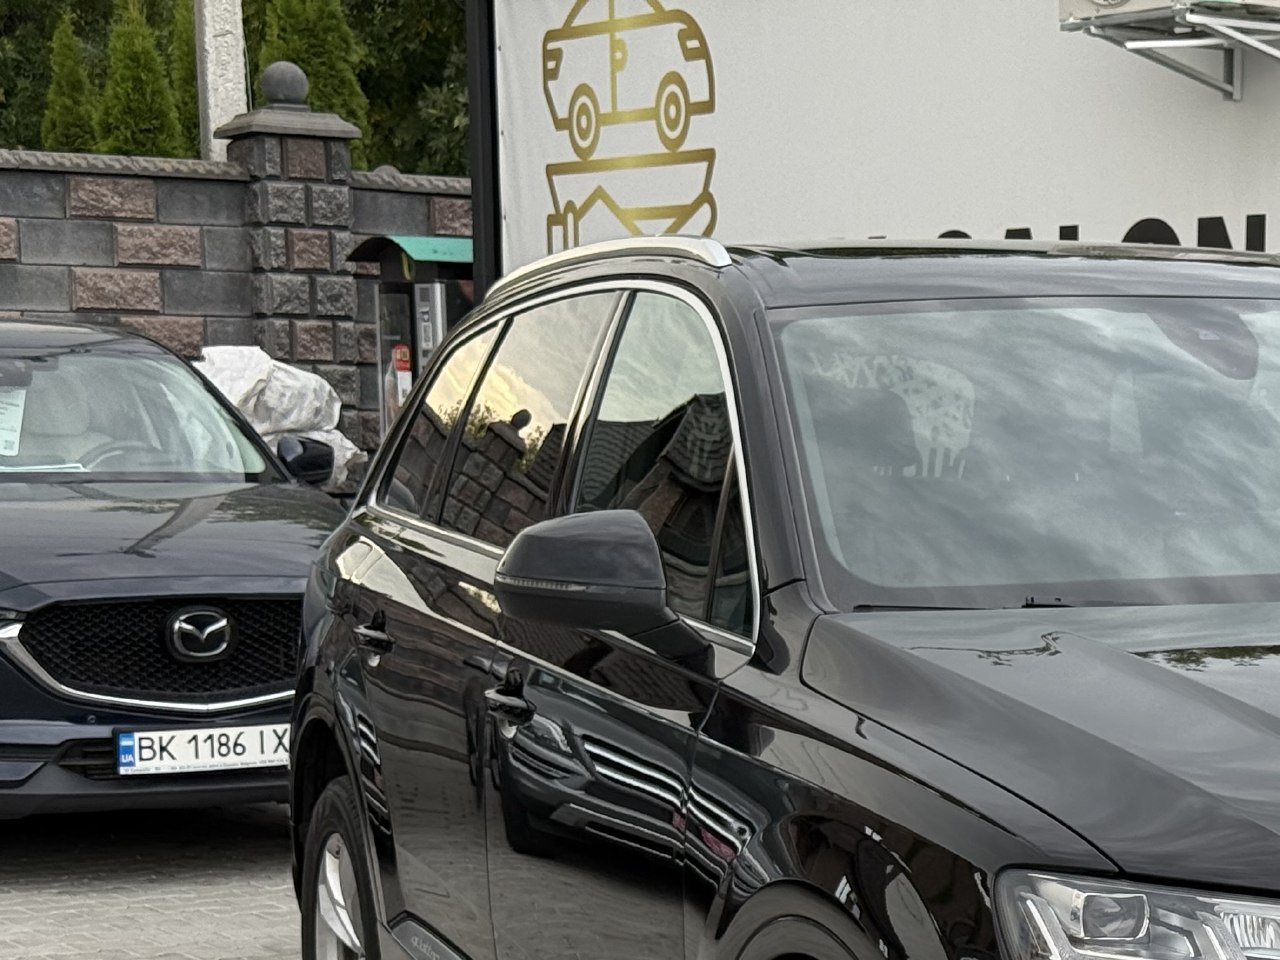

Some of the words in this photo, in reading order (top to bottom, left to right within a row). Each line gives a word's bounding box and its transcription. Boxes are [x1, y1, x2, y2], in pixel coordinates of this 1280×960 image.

[138, 735, 177, 762] BK
[187, 731, 247, 760] 1186
[260, 728, 289, 755] IX
[121, 754, 134, 763] UA
